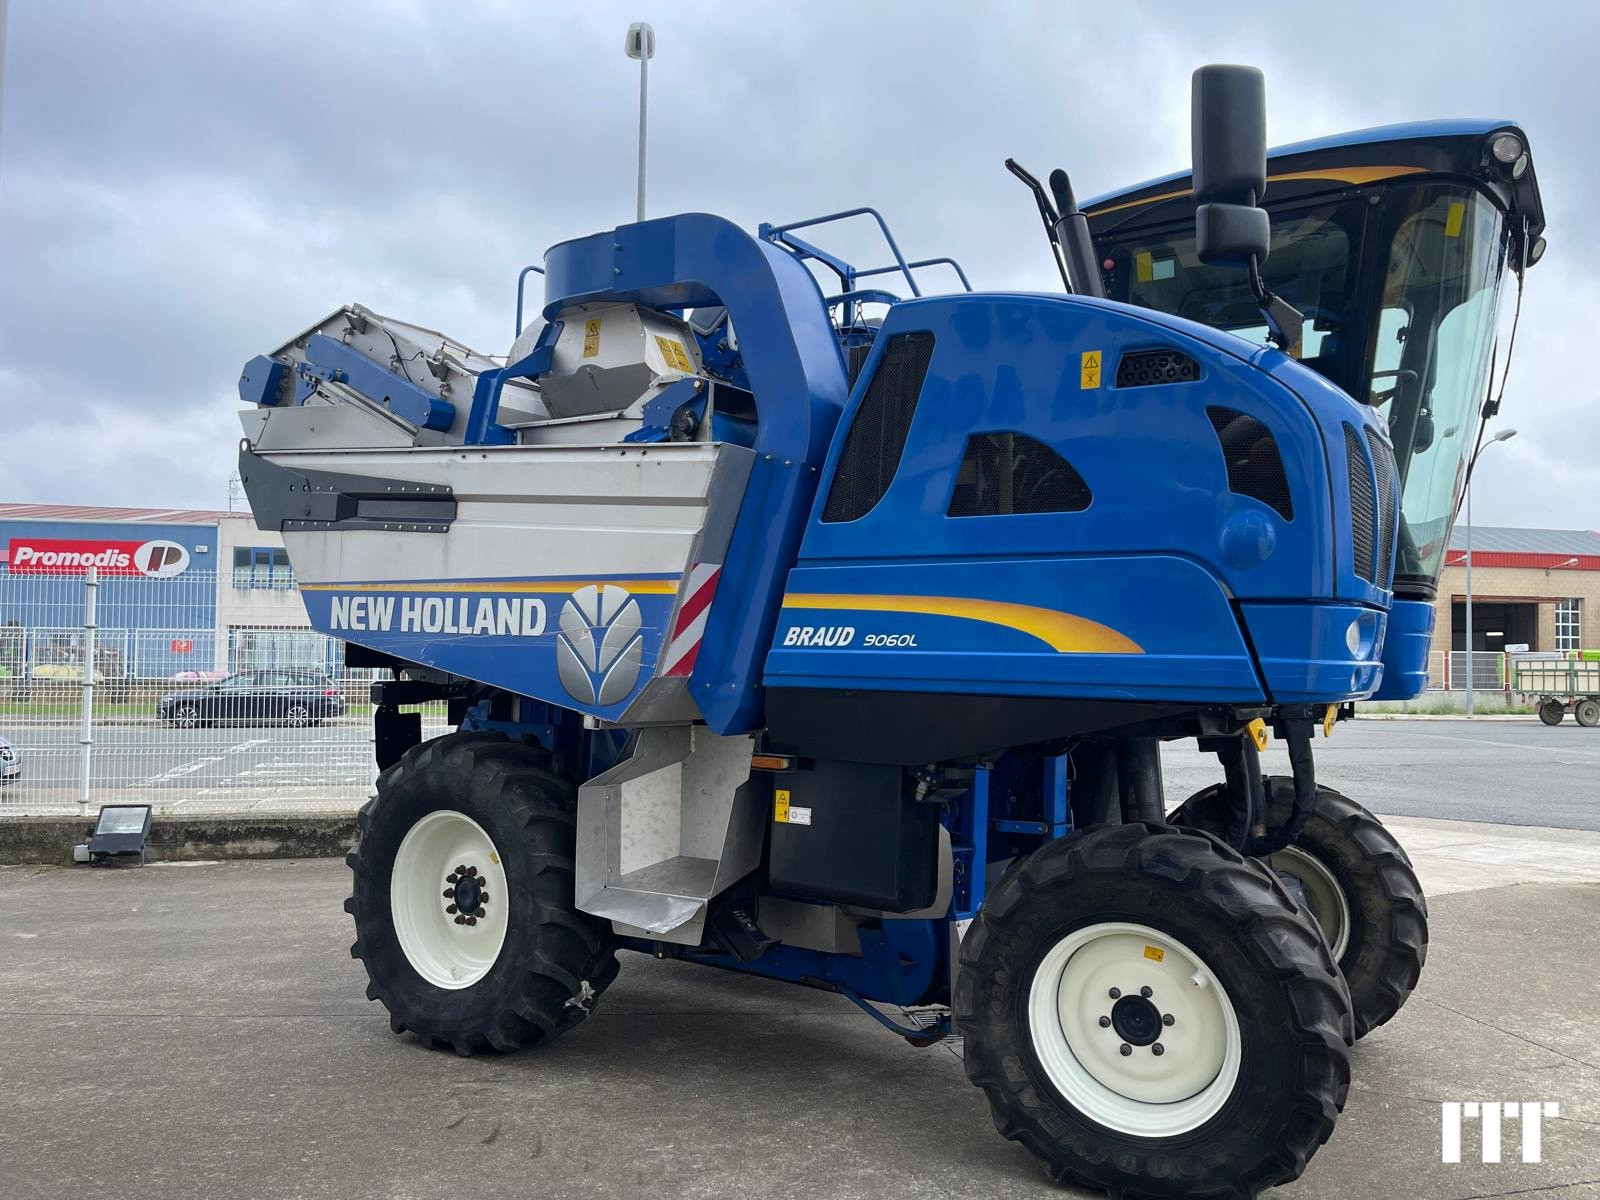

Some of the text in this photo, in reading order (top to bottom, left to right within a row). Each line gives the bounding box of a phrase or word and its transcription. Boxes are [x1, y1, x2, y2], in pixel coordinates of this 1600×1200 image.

[14, 547, 131, 567] Promodis
[330, 595, 547, 636] NEW HOLLAND
[783, 626, 918, 647] BRAUD 9060L
